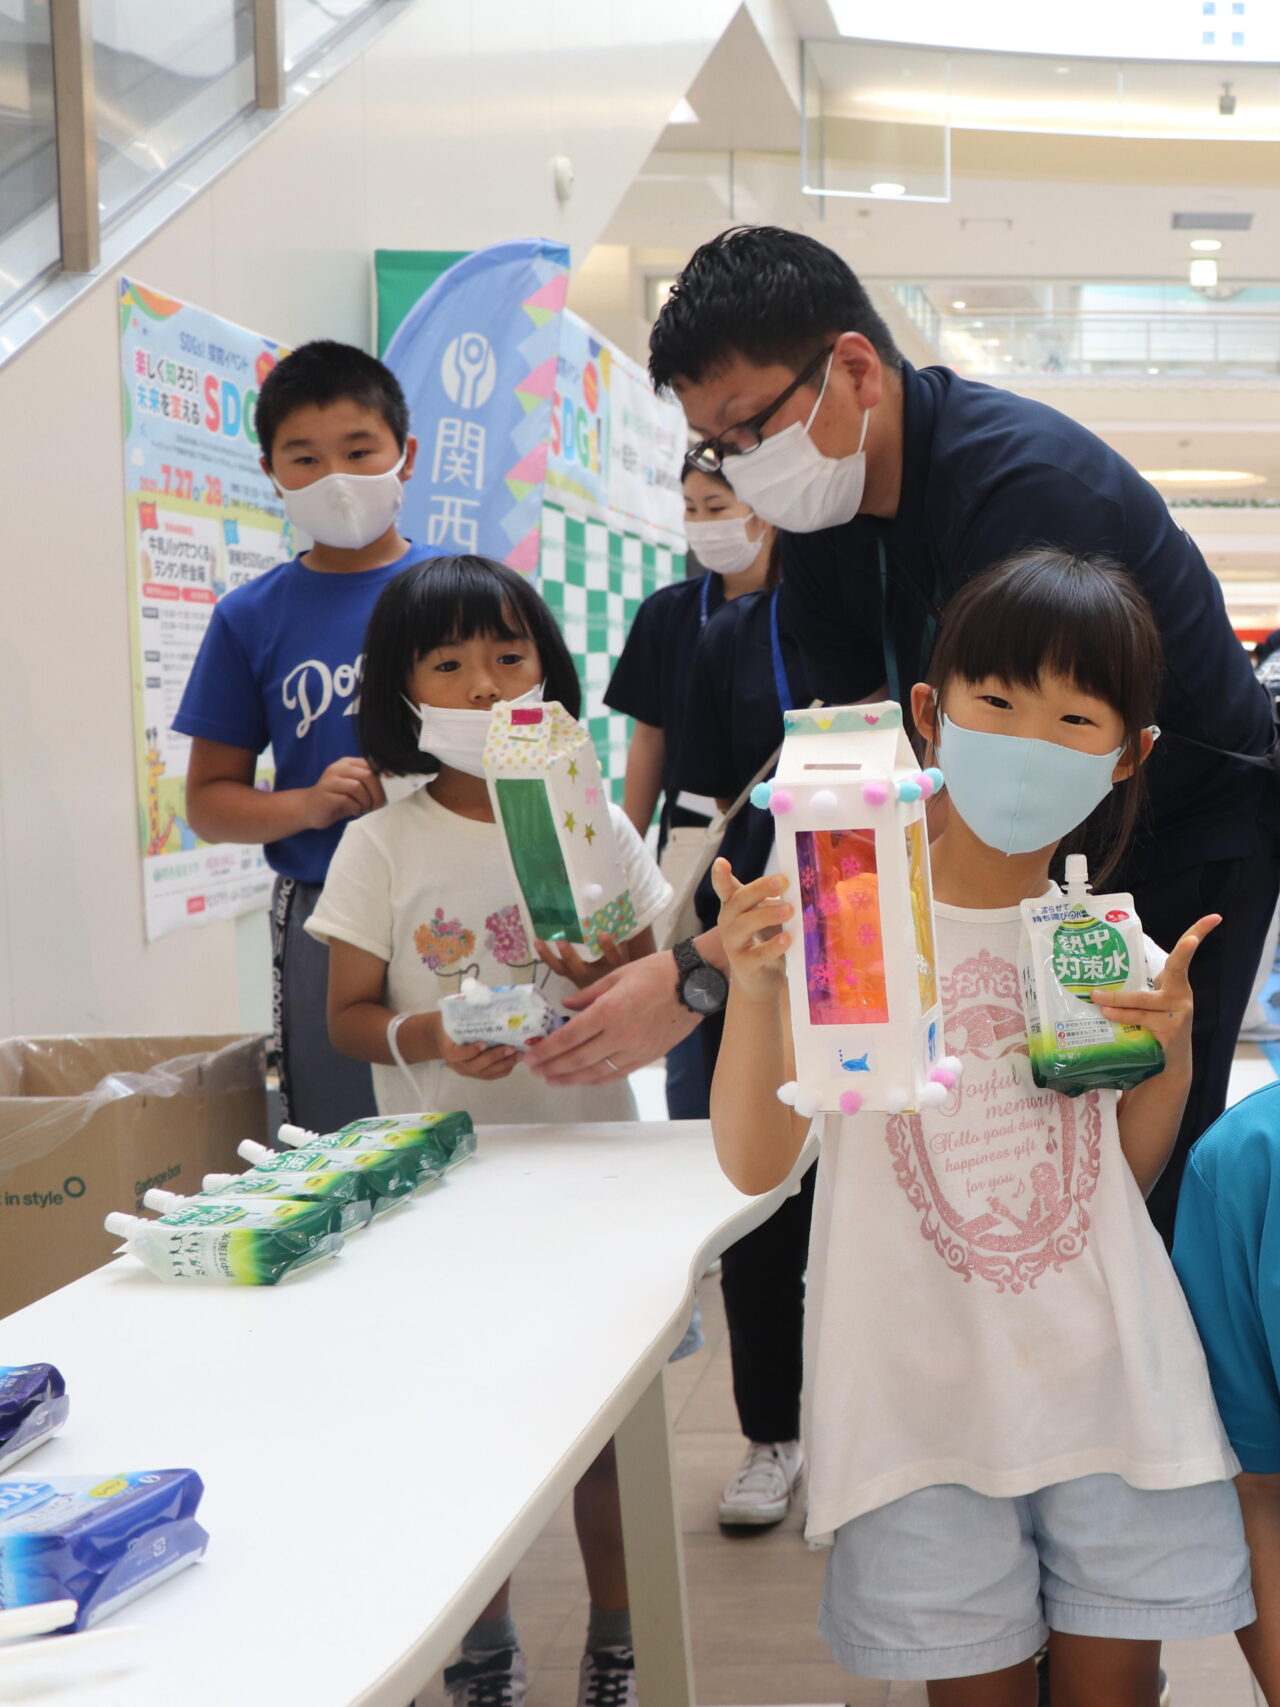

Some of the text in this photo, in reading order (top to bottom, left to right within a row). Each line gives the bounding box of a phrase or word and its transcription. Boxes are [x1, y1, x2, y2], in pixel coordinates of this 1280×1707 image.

[1057, 929, 1110, 955] 熱中
[1055, 951, 1129, 981] 対策水
[929, 1116, 1046, 1155] Hello good days
[945, 1137, 1037, 1173] happiness gift
[5, 1191, 63, 1209] in style
[965, 1173, 1019, 1199] for you
